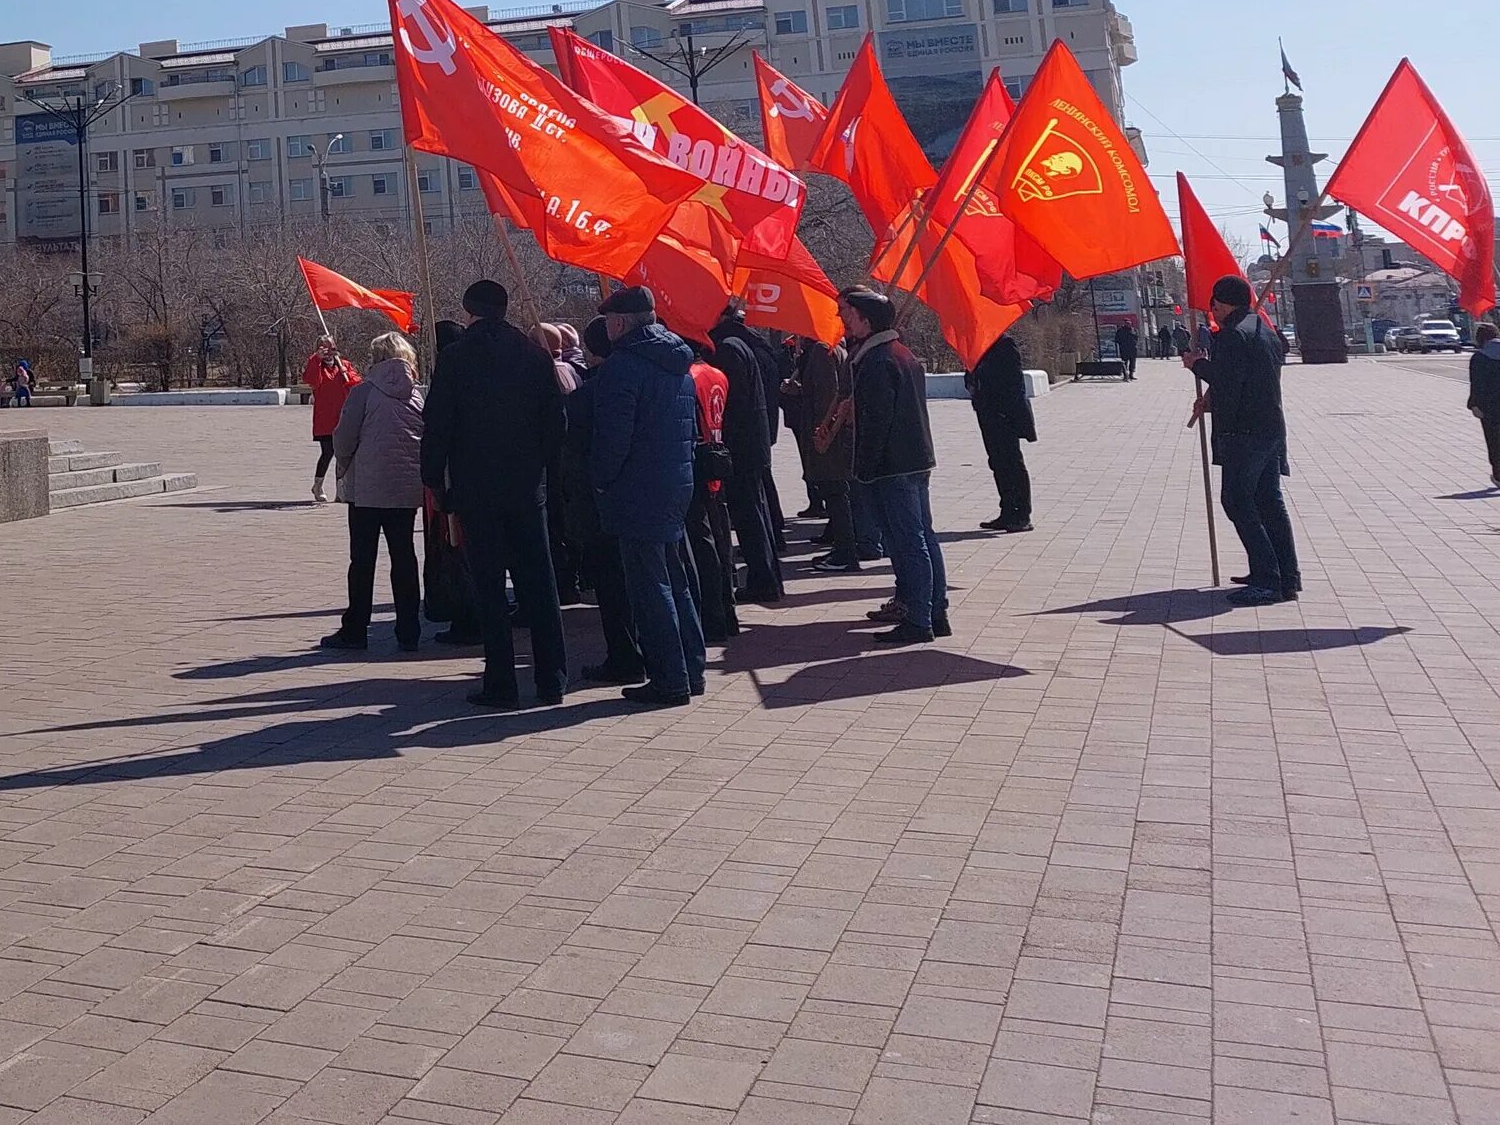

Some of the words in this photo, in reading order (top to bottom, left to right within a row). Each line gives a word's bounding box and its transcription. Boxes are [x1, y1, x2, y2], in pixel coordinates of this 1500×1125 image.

[906, 40, 925, 50] МЫ
[927, 35, 973, 48] ВМЕСТЕ
[668, 131, 804, 209] ВОЙНЫ
[1107, 149, 1141, 214] КОМСОМОЛ
